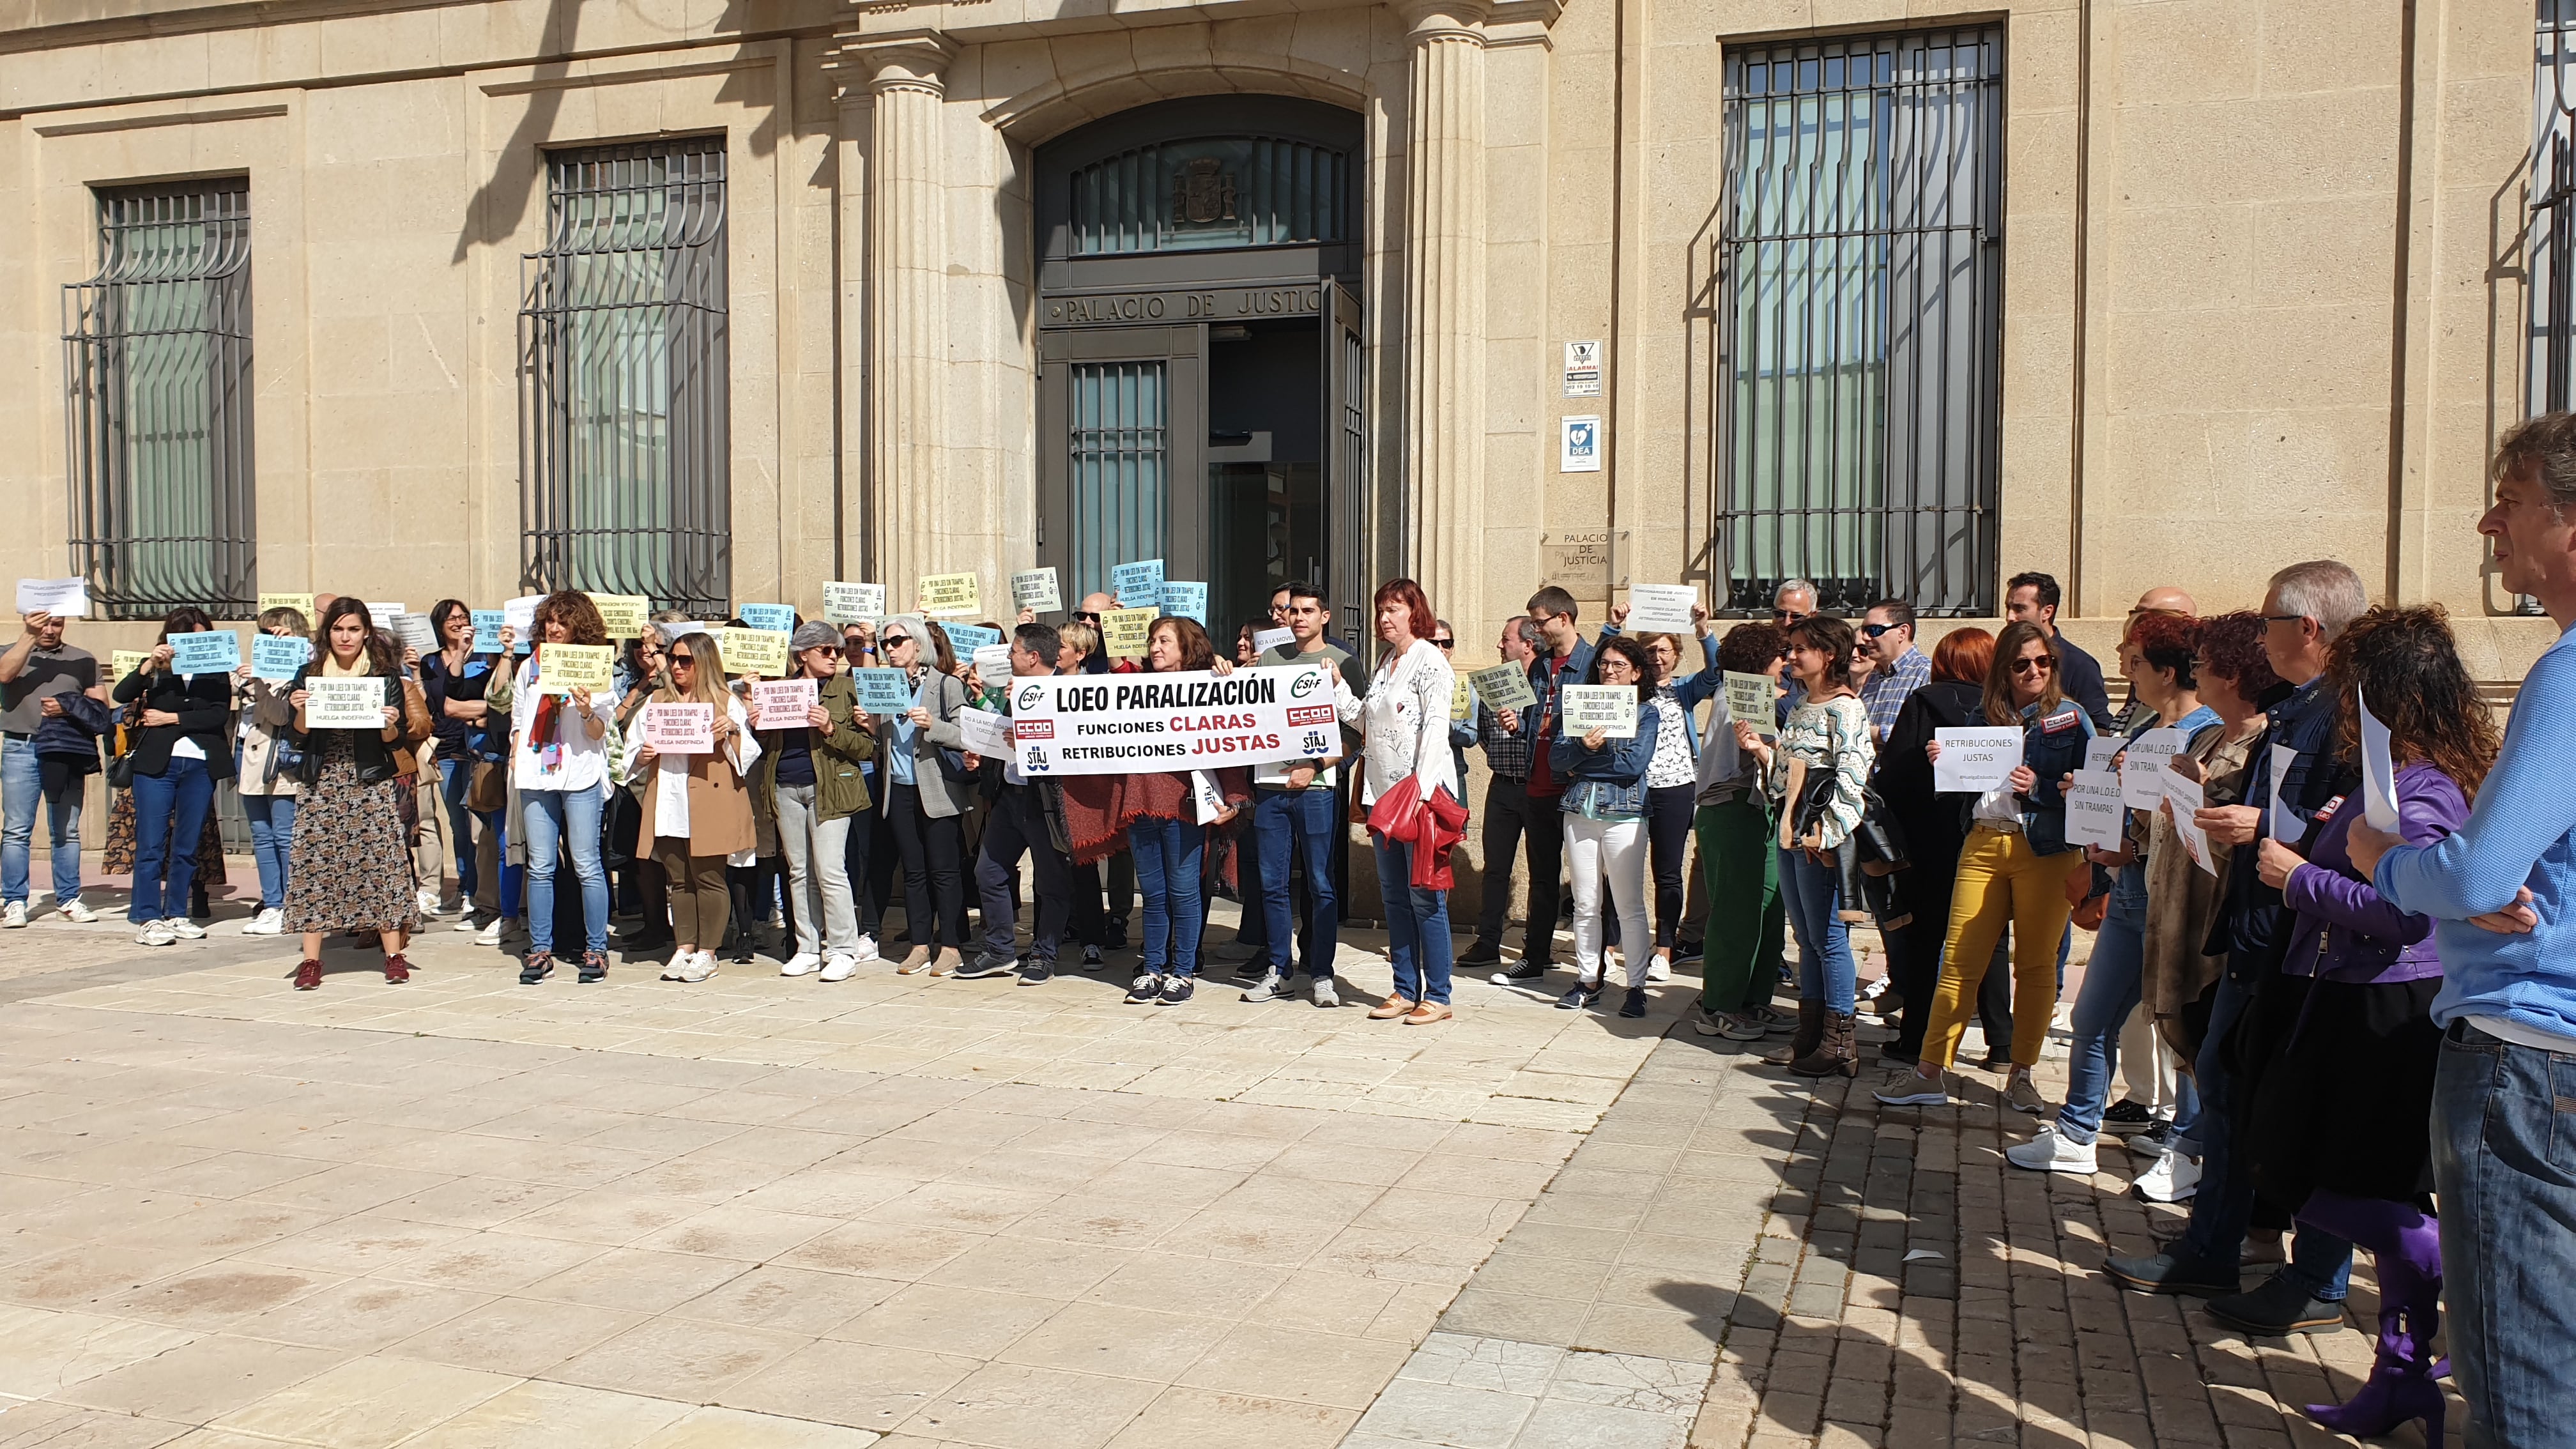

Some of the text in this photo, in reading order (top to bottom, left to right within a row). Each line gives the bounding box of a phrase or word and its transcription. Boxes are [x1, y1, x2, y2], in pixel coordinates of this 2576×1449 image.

[1066, 289, 1321, 322] PALACIO DE JUSTIC
[1565, 534, 1607, 542] PALACIO
[1564, 556, 1607, 567] JUSTICIA
[761, 635, 775, 643] TRAMPAS
[737, 652, 758, 660] RETRIBUCIONES
[562, 660, 579, 668] FUNCIONES
[558, 670, 582, 678] RETRIBUCIONES
[1057, 673, 1275, 712] LOEO PARALIZACIÓN
[1290, 707, 1331, 720] CCOO
[983, 721, 1008, 730] MOVILIDAD
[1078, 713, 1256, 735] FUNCIONES CLARAS
[2047, 715, 2072, 726] CCOO
[977, 727, 996, 735] FORZOSA
[1017, 723, 1052, 732] CCOO
[1062, 733, 1280, 759] RETRIBUCIONES JUSTAS
[1303, 735, 1326, 749] STAJ
[2141, 744, 2153, 753] UNA
[1027, 751, 1047, 764] STAJ
[2129, 761, 2158, 772] SIN TRAM
[2073, 785, 2085, 793] POR
[2087, 785, 2099, 795] UNA
[2075, 801, 2113, 814] SIN TRAMPAS
